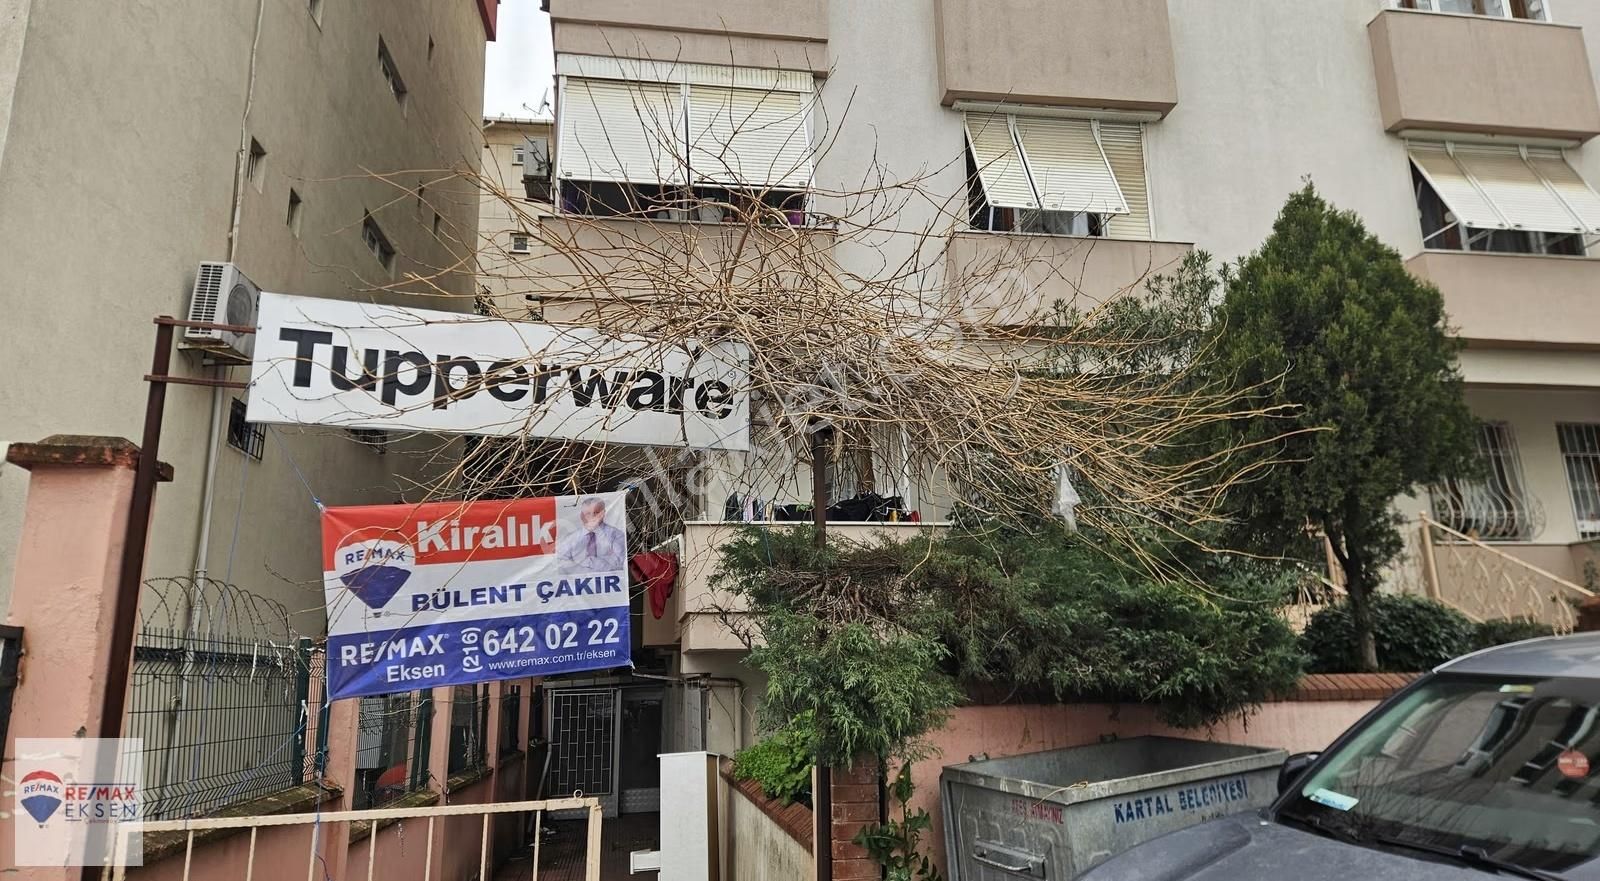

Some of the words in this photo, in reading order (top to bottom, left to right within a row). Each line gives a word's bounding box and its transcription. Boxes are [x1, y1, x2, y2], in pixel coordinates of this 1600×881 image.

[279, 327, 734, 420] Tupperware
[417, 513, 555, 553] Kiralık
[345, 548, 406, 565] RE/MAX
[411, 583, 527, 612] BÜLENT
[536, 575, 622, 603] ÇAKIR
[341, 633, 446, 667] RE/MAX
[460, 627, 483, 673] (216)
[483, 626, 535, 656] 642
[545, 622, 578, 650] 02
[587, 618, 620, 646] 22
[488, 650, 616, 671] www.remax.com.tr/eksen
[386, 664, 446, 683] Eksen
[1114, 795, 1173, 824] KARTAL
